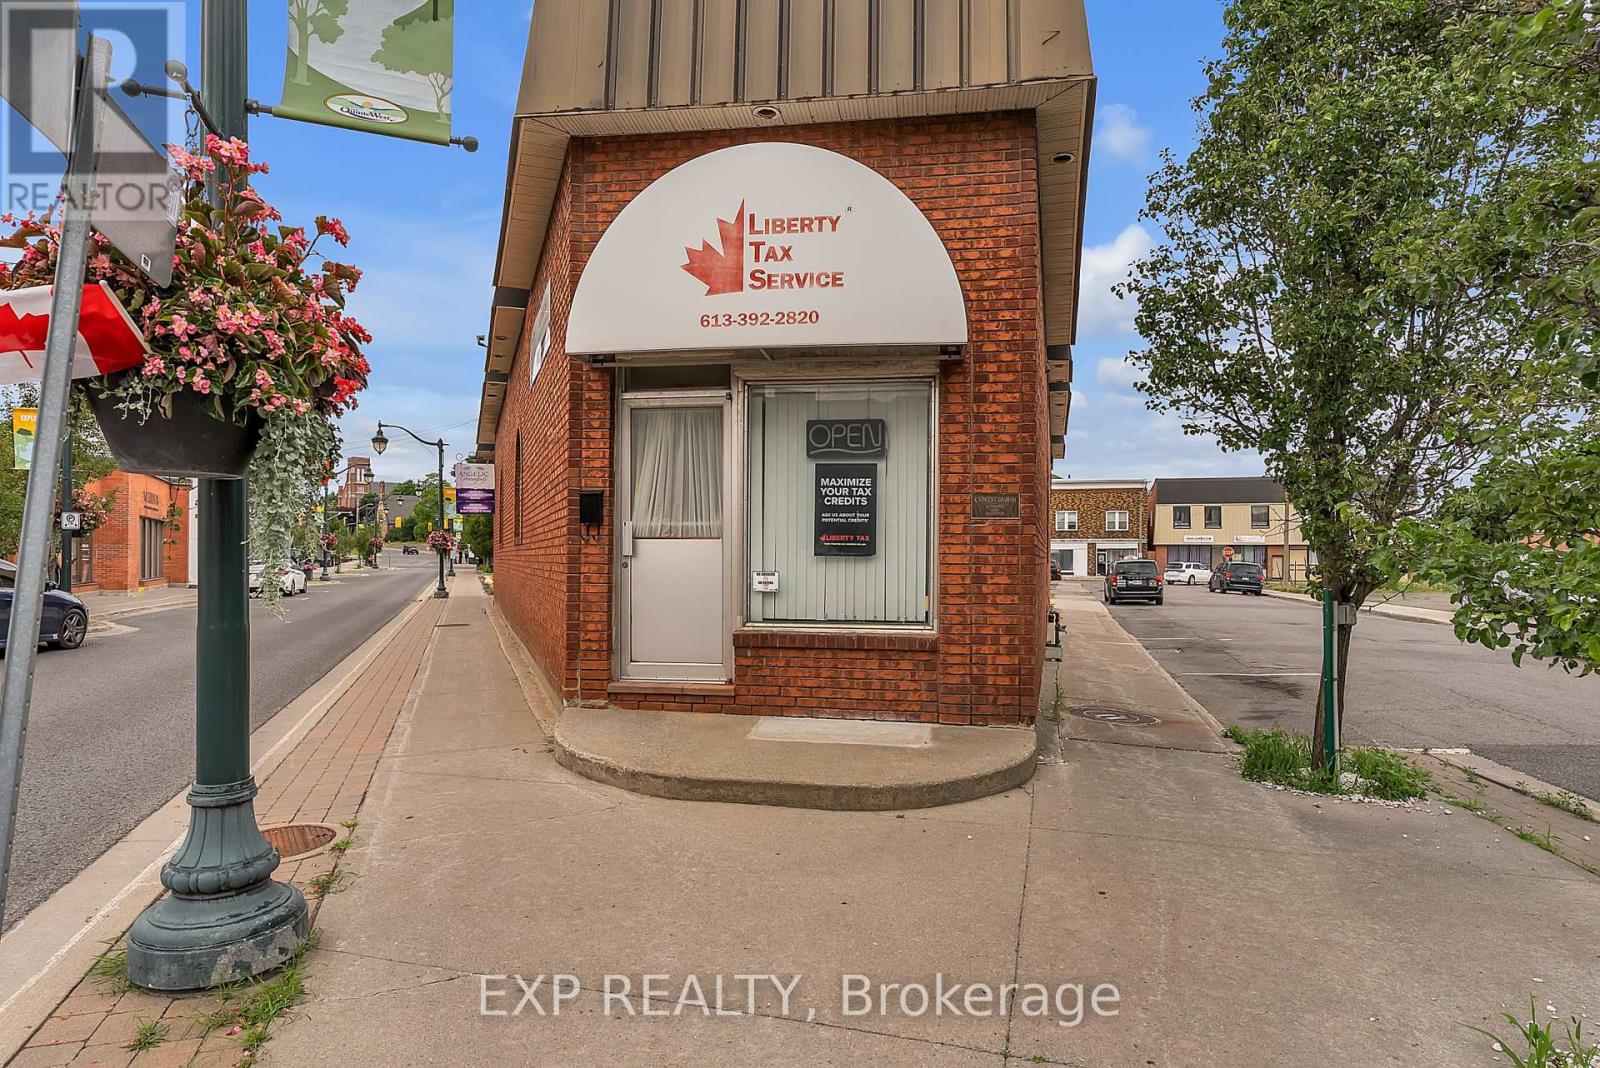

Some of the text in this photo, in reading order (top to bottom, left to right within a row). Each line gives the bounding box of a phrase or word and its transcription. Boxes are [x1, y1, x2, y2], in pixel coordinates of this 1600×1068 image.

[700, 310, 820, 328] 613-392-2820
[809, 423, 882, 448] OPEN
[820, 478, 872, 486] MAXIMIZE
[820, 487, 872, 496] YOUR TAX
[824, 497, 868, 505] CREDITS
